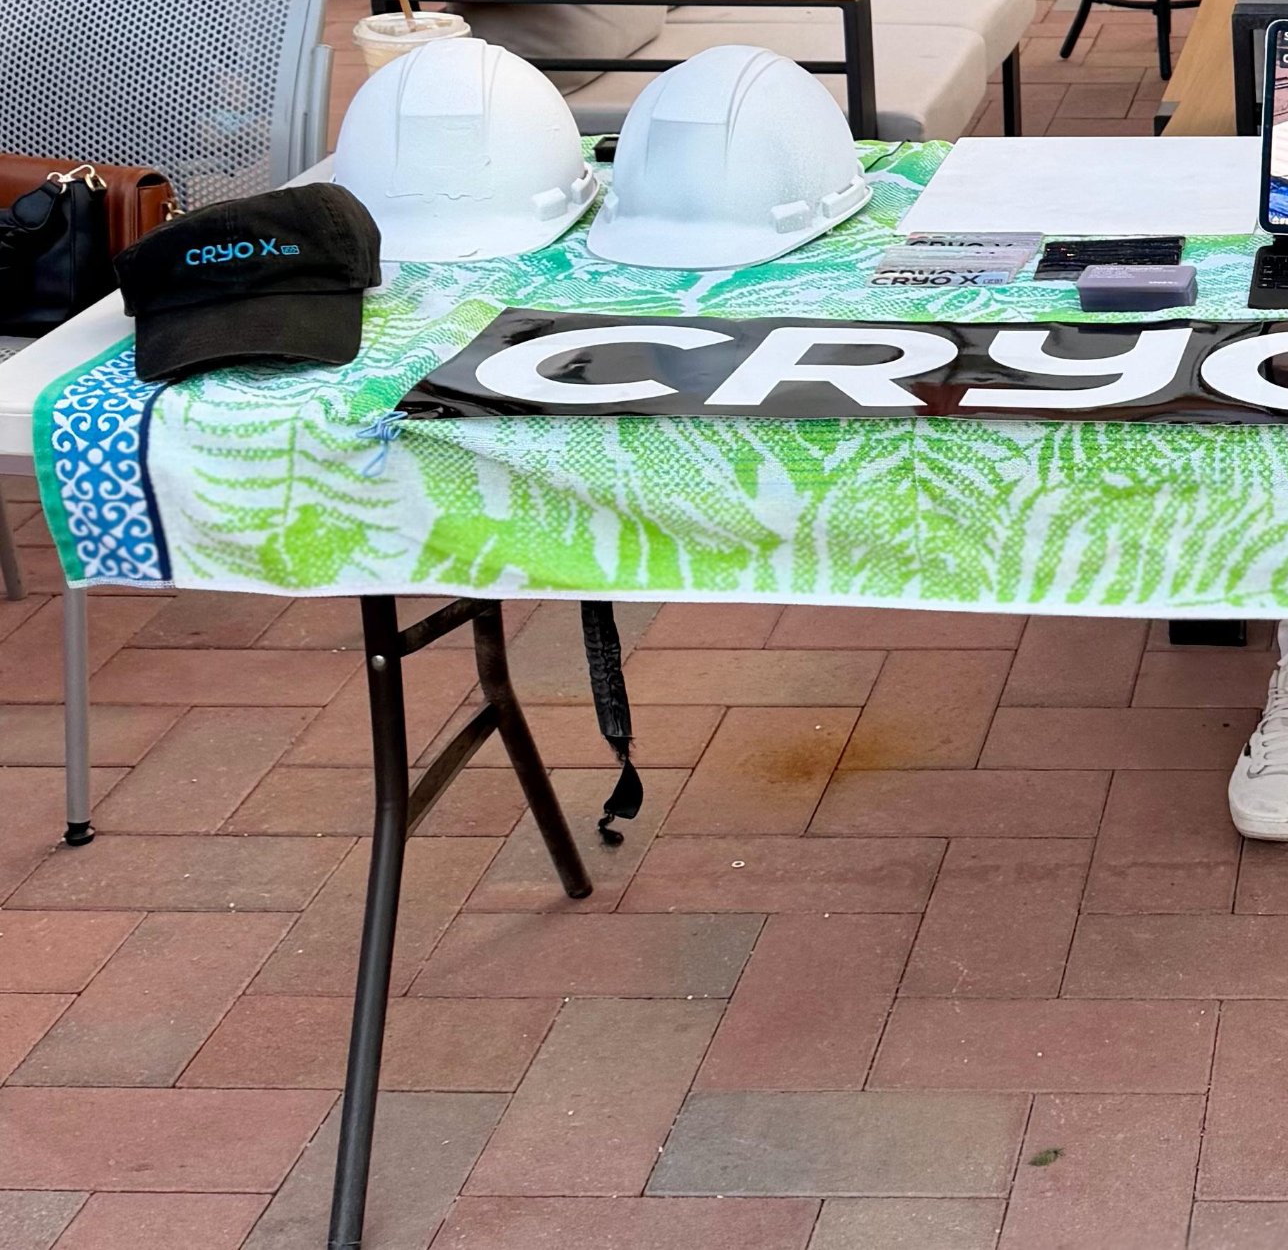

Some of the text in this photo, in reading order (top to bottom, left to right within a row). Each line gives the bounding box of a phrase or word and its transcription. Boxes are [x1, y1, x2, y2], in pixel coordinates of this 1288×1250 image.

[186, 241, 254, 265] CRYO
[259, 238, 280, 256] X
[871, 275, 951, 286] CRYO
[960, 275, 981, 285] X
